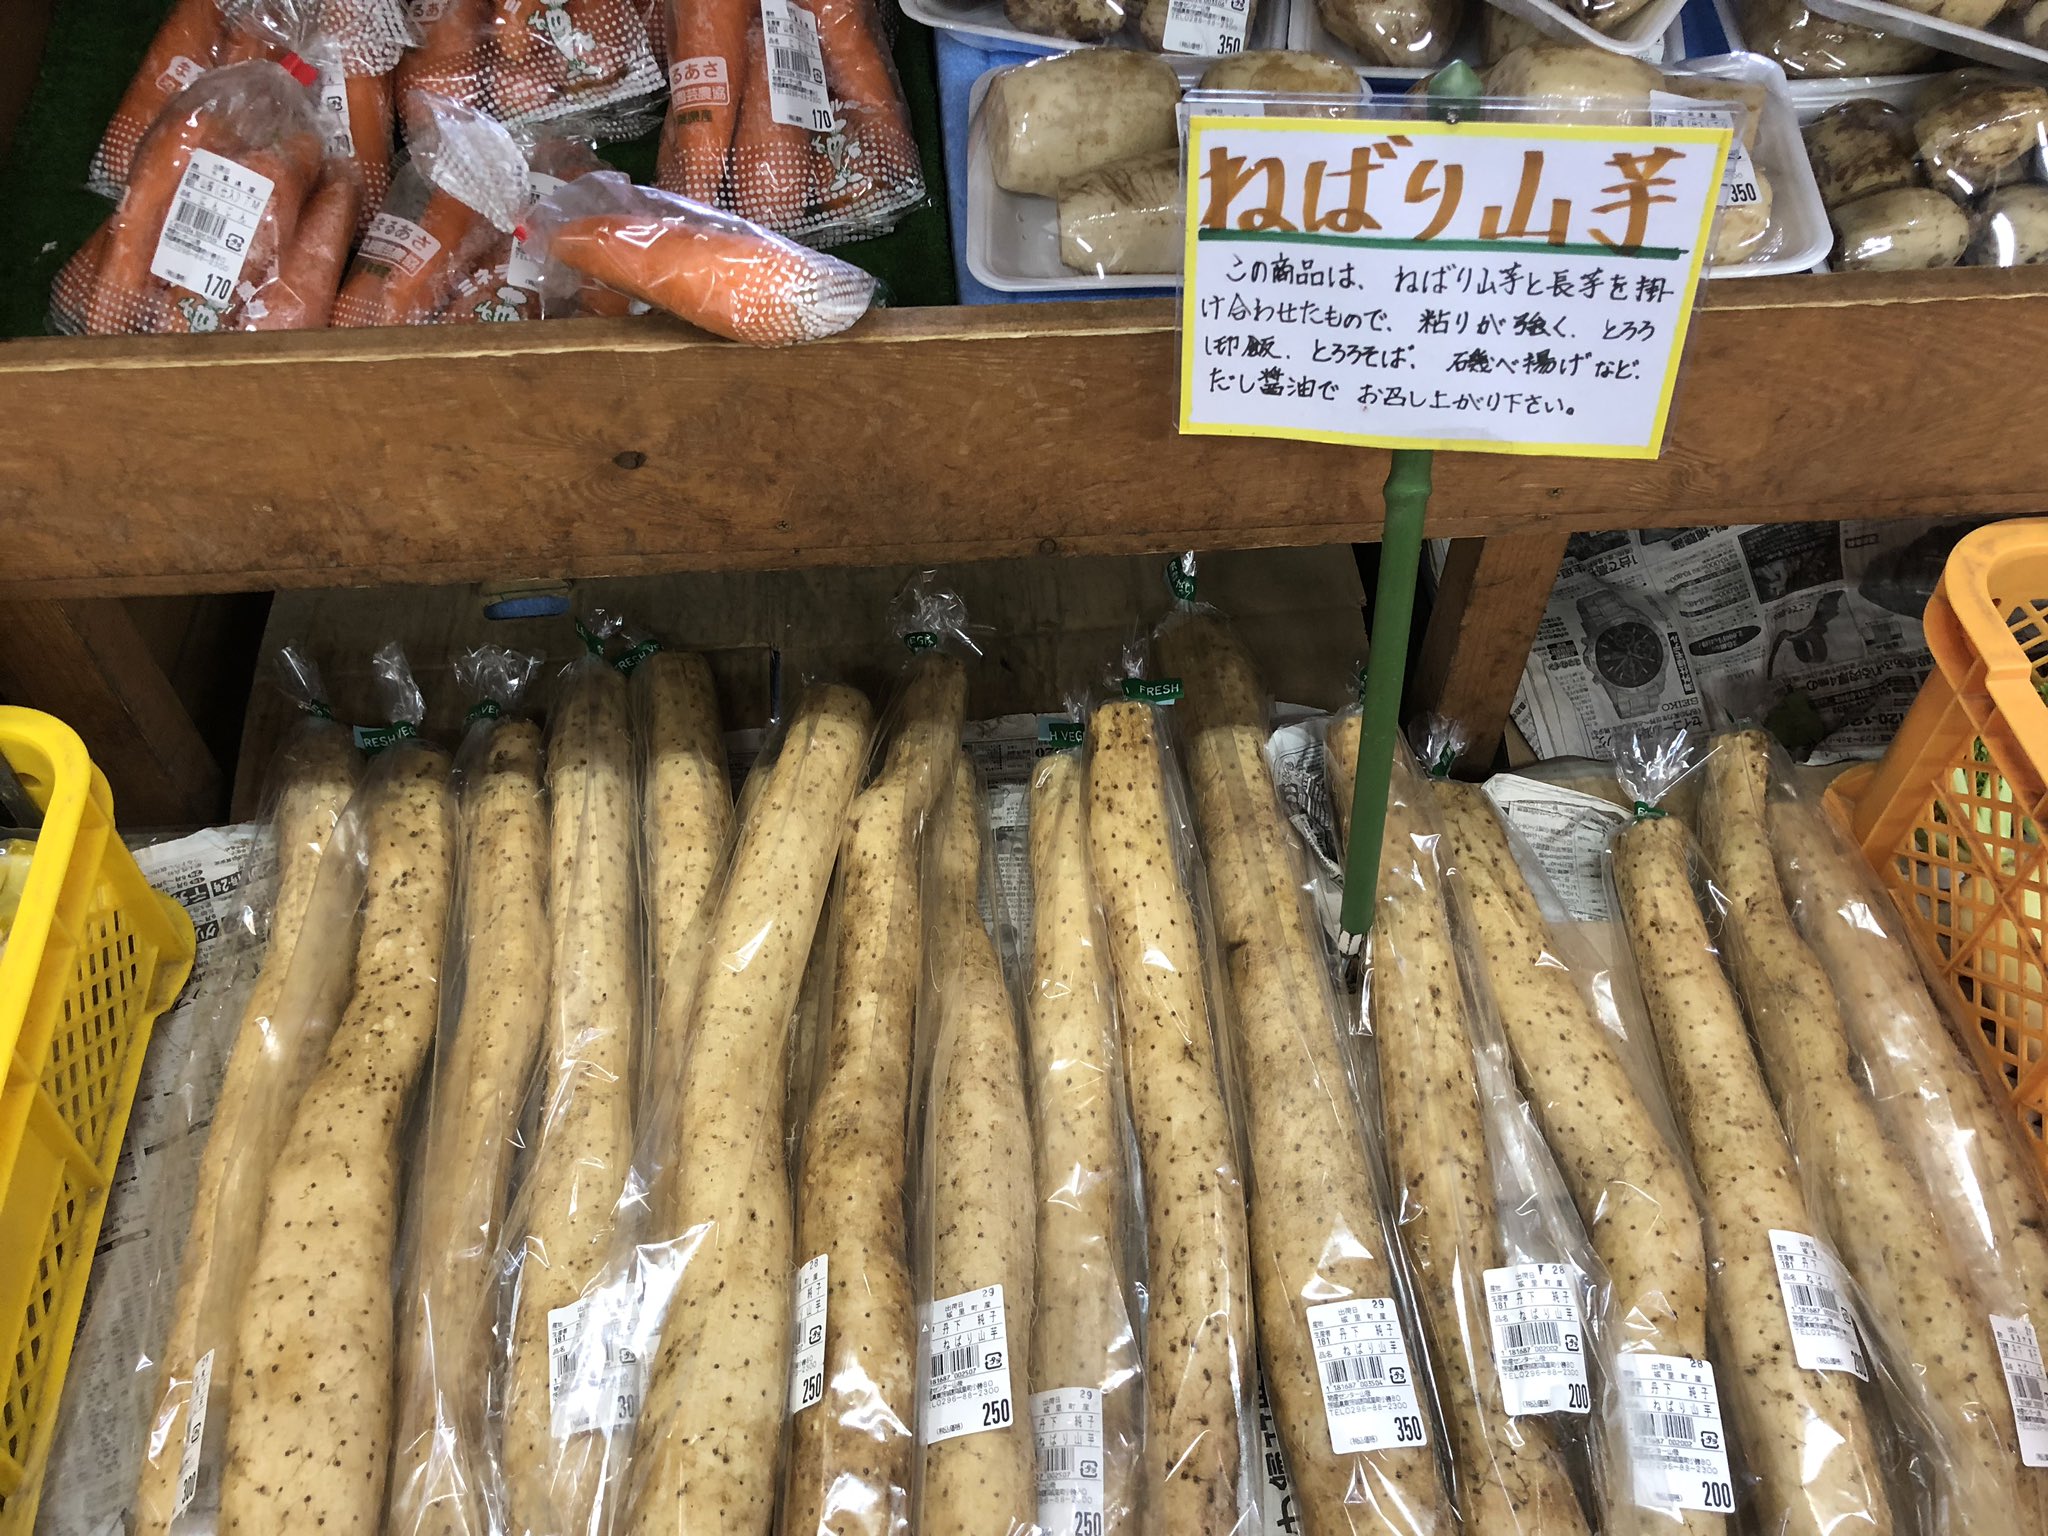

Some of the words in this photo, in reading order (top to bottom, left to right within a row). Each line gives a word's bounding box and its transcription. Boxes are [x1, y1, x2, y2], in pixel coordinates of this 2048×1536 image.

[1217, 34, 1241, 54] 350
[812, 109, 832, 129] 170
[1199, 134, 1687, 256] ねばり山芋
[1730, 182, 1757, 202] 350
[204, 273, 232, 299] 170
[1395, 263, 1674, 303] ねばり山芋と長芋を掛
[1602, 319, 1655, 342] とろろ
[1356, 383, 1576, 416] お召し上がり下さい。
[1139, 683, 1179, 697] FRESH
[1661, 696, 1699, 711] SEIKO
[1552, 1265, 1565, 1275] 28
[1782, 1261, 1794, 1269] 181
[982, 1288, 995, 1297] 29
[1372, 1300, 1385, 1309] 29
[555, 1335, 566, 1343] 181
[944, 1327, 999, 1351] ねばり山芋
[1318, 1338, 1330, 1346] 181
[1690, 1360, 1704, 1368] 28
[802, 1373, 822, 1404] 250
[1080, 1389, 1093, 1400] 29
[1569, 1383, 1589, 1409] 200
[982, 1399, 1010, 1426] 250
[1394, 1416, 1422, 1442] 350
[1702, 1481, 1732, 1508] 200
[1075, 1511, 1101, 1536] 250
